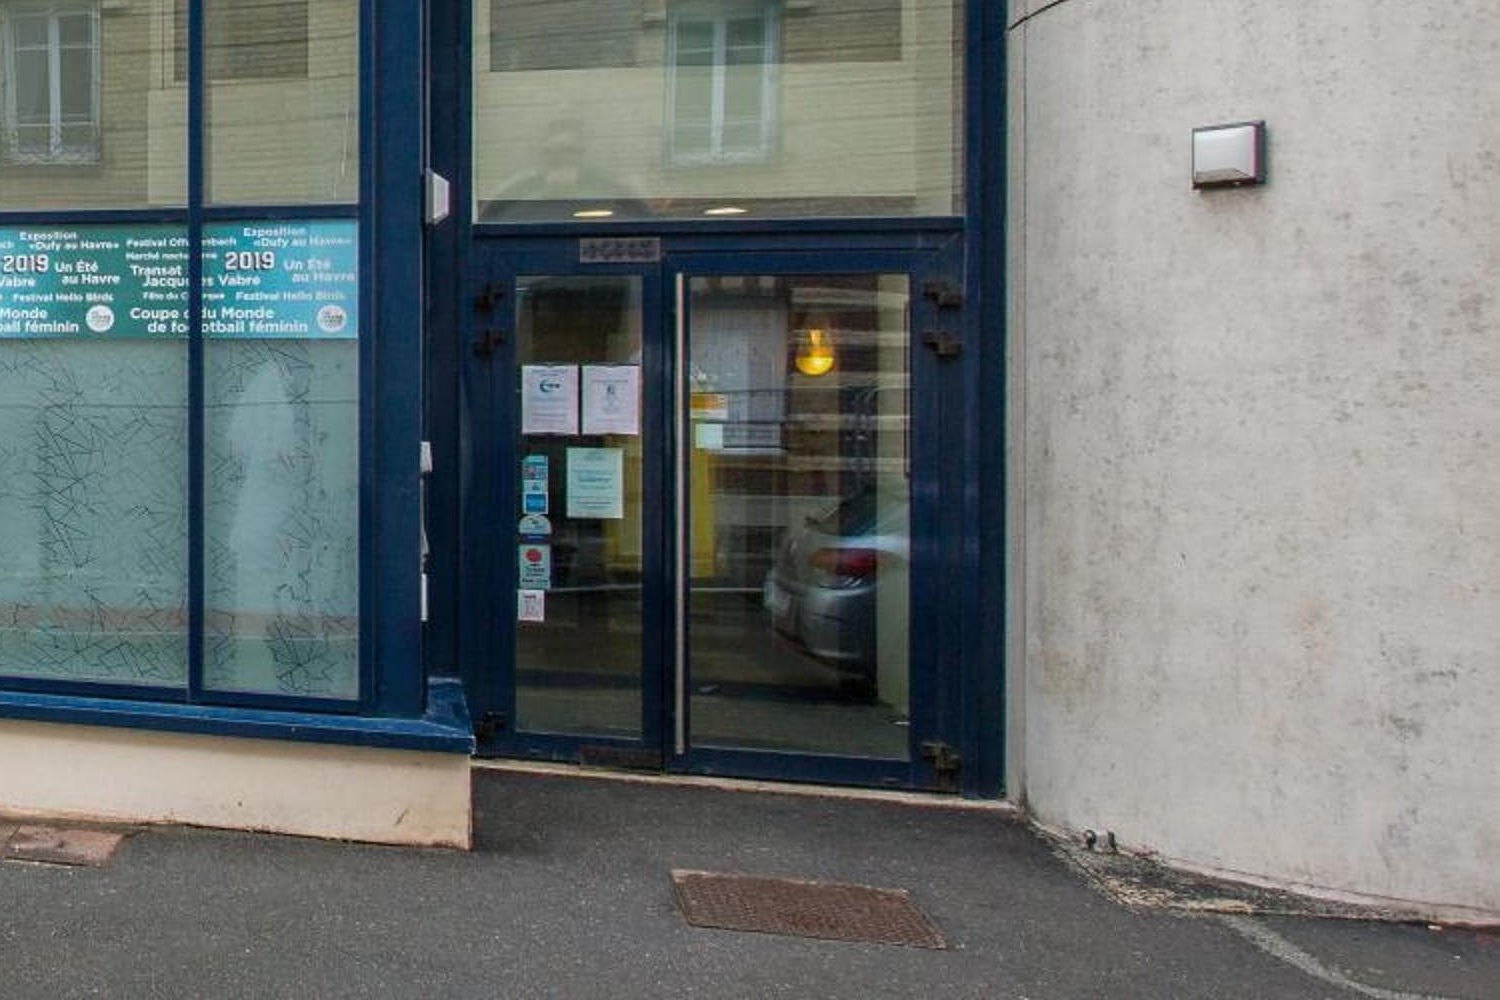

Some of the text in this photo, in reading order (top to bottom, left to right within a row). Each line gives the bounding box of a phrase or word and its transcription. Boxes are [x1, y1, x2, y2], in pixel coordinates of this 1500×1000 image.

[3, 255, 49, 272] 2019
[55, 260, 72, 272] Un
[225, 251, 275, 269] 2019
[130, 264, 182, 276] Transat
[62, 274, 78, 284] au
[218, 274, 260, 288] Vabre
[0, 307, 48, 321] Monde
[130, 306, 179, 320] Coupe
[221, 306, 274, 320] Monde
[148, 320, 167, 333] de
[249, 320, 308, 333] féminin
